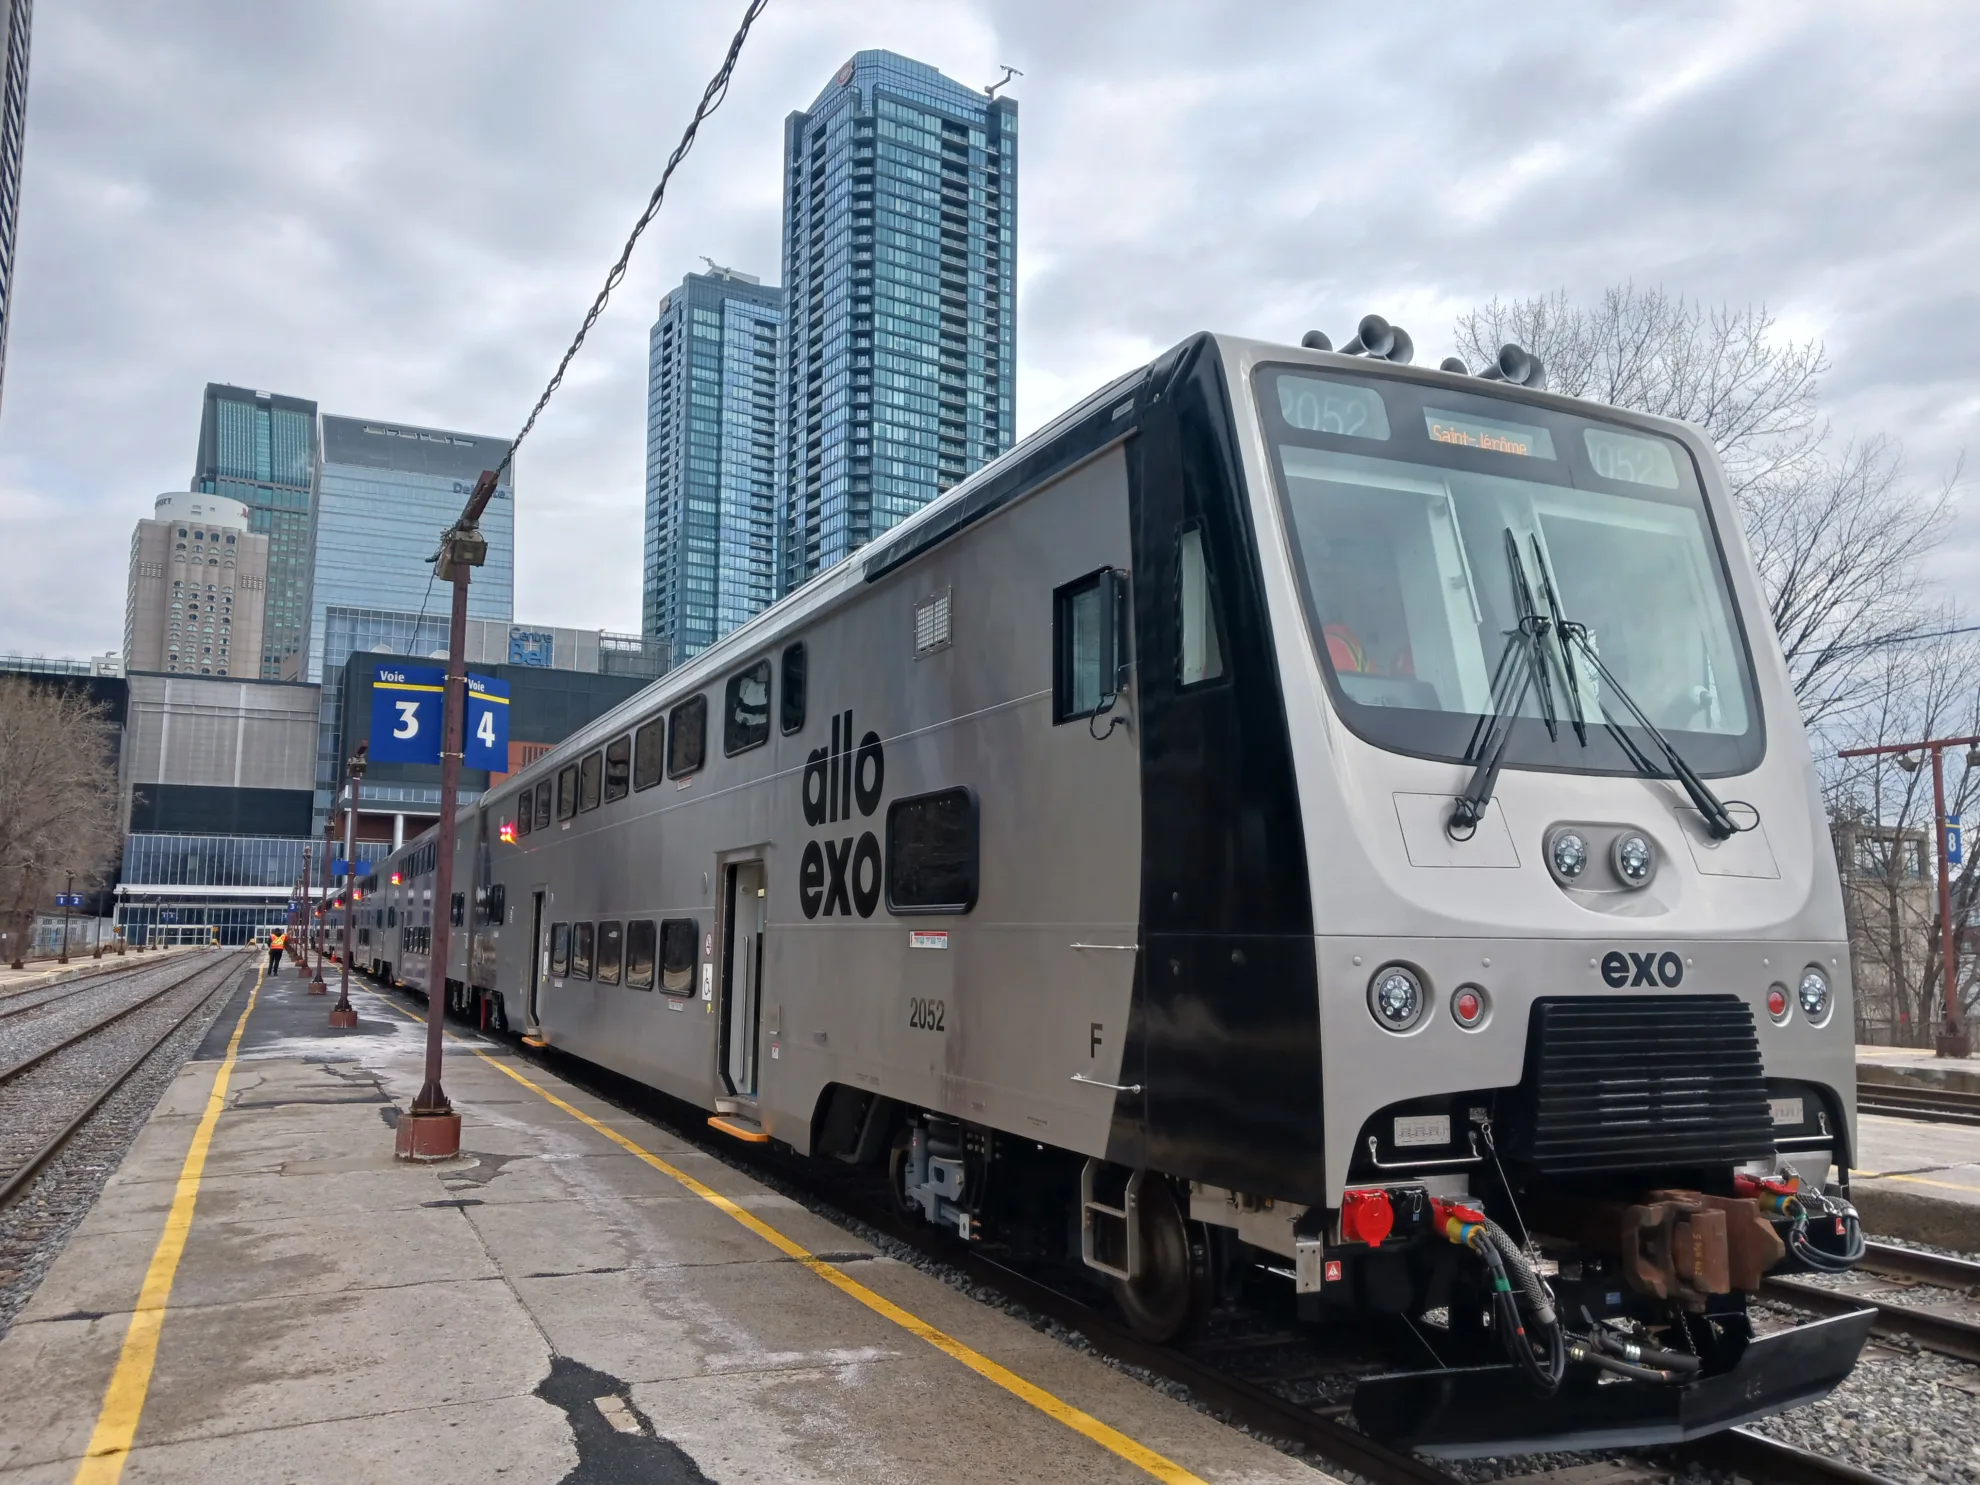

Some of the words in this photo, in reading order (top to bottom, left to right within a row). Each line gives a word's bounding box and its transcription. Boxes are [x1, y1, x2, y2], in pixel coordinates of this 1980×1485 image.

[453, 482, 506, 499] Delte
[510, 627, 553, 644] Centre
[510, 641, 553, 667] Bell
[380, 670, 405, 683] Voie
[468, 679, 485, 692] Voie
[393, 701, 420, 739] 3
[477, 711, 496, 748] 4
[802, 709, 885, 827] allo
[1948, 832, 1957, 852] 8
[800, 831, 882, 920] exo
[1601, 951, 1684, 988] exo
[909, 997, 945, 1031] 2052
[1090, 1022, 1103, 1058] F
